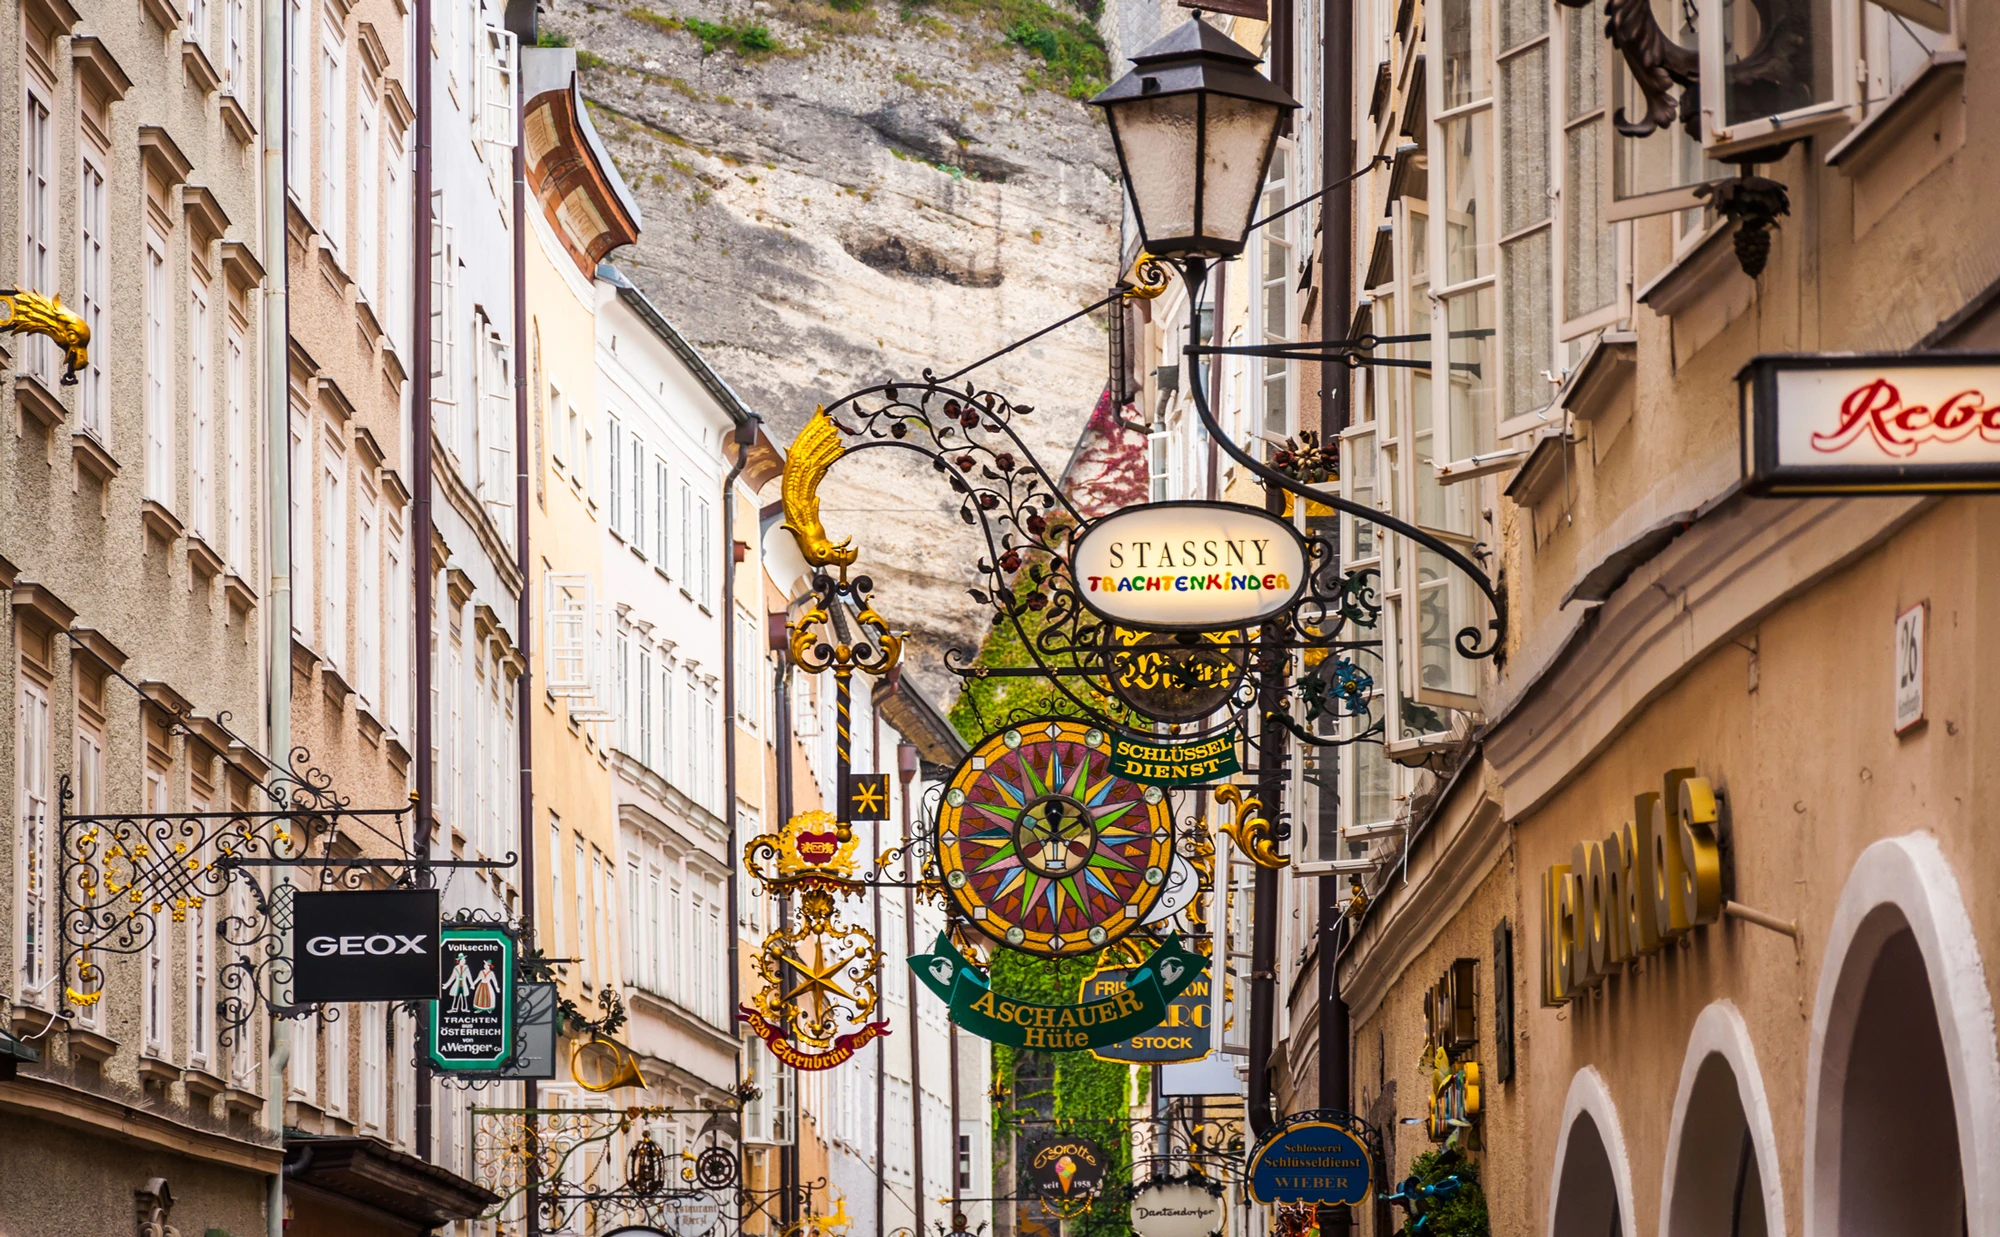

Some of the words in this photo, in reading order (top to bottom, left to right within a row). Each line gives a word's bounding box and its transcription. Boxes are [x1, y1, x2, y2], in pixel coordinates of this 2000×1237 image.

[1110, 539, 1270, 569] STASSNY
[1901, 615, 1918, 689] 26
[1117, 737, 1233, 763] SCHLÜSSEL
[1124, 757, 1220, 779] DIENST
[306, 935, 427, 956] GEOX
[448, 944, 498, 952] Volksechte
[969, 989, 1144, 1029] ASCHAUER
[440, 1025, 501, 1036] ÖSTERREICH
[1023, 1027, 1089, 1048] Hüte
[749, 1013, 771, 1039] 1720
[771, 1038, 850, 1069] Sternbräu
[852, 1026, 877, 1048] 1976
[1131, 1037, 1193, 1049] STOCK
[1285, 1144, 1342, 1153] Schlosserei
[1264, 1157, 1361, 1168] Schlüsseldienst
[1043, 1181, 1059, 1189] seit
[1073, 1180, 1091, 1188] 1958
[1275, 1177, 1349, 1189] WIEBER
[1136, 1206, 1215, 1219] Dantendorfer
